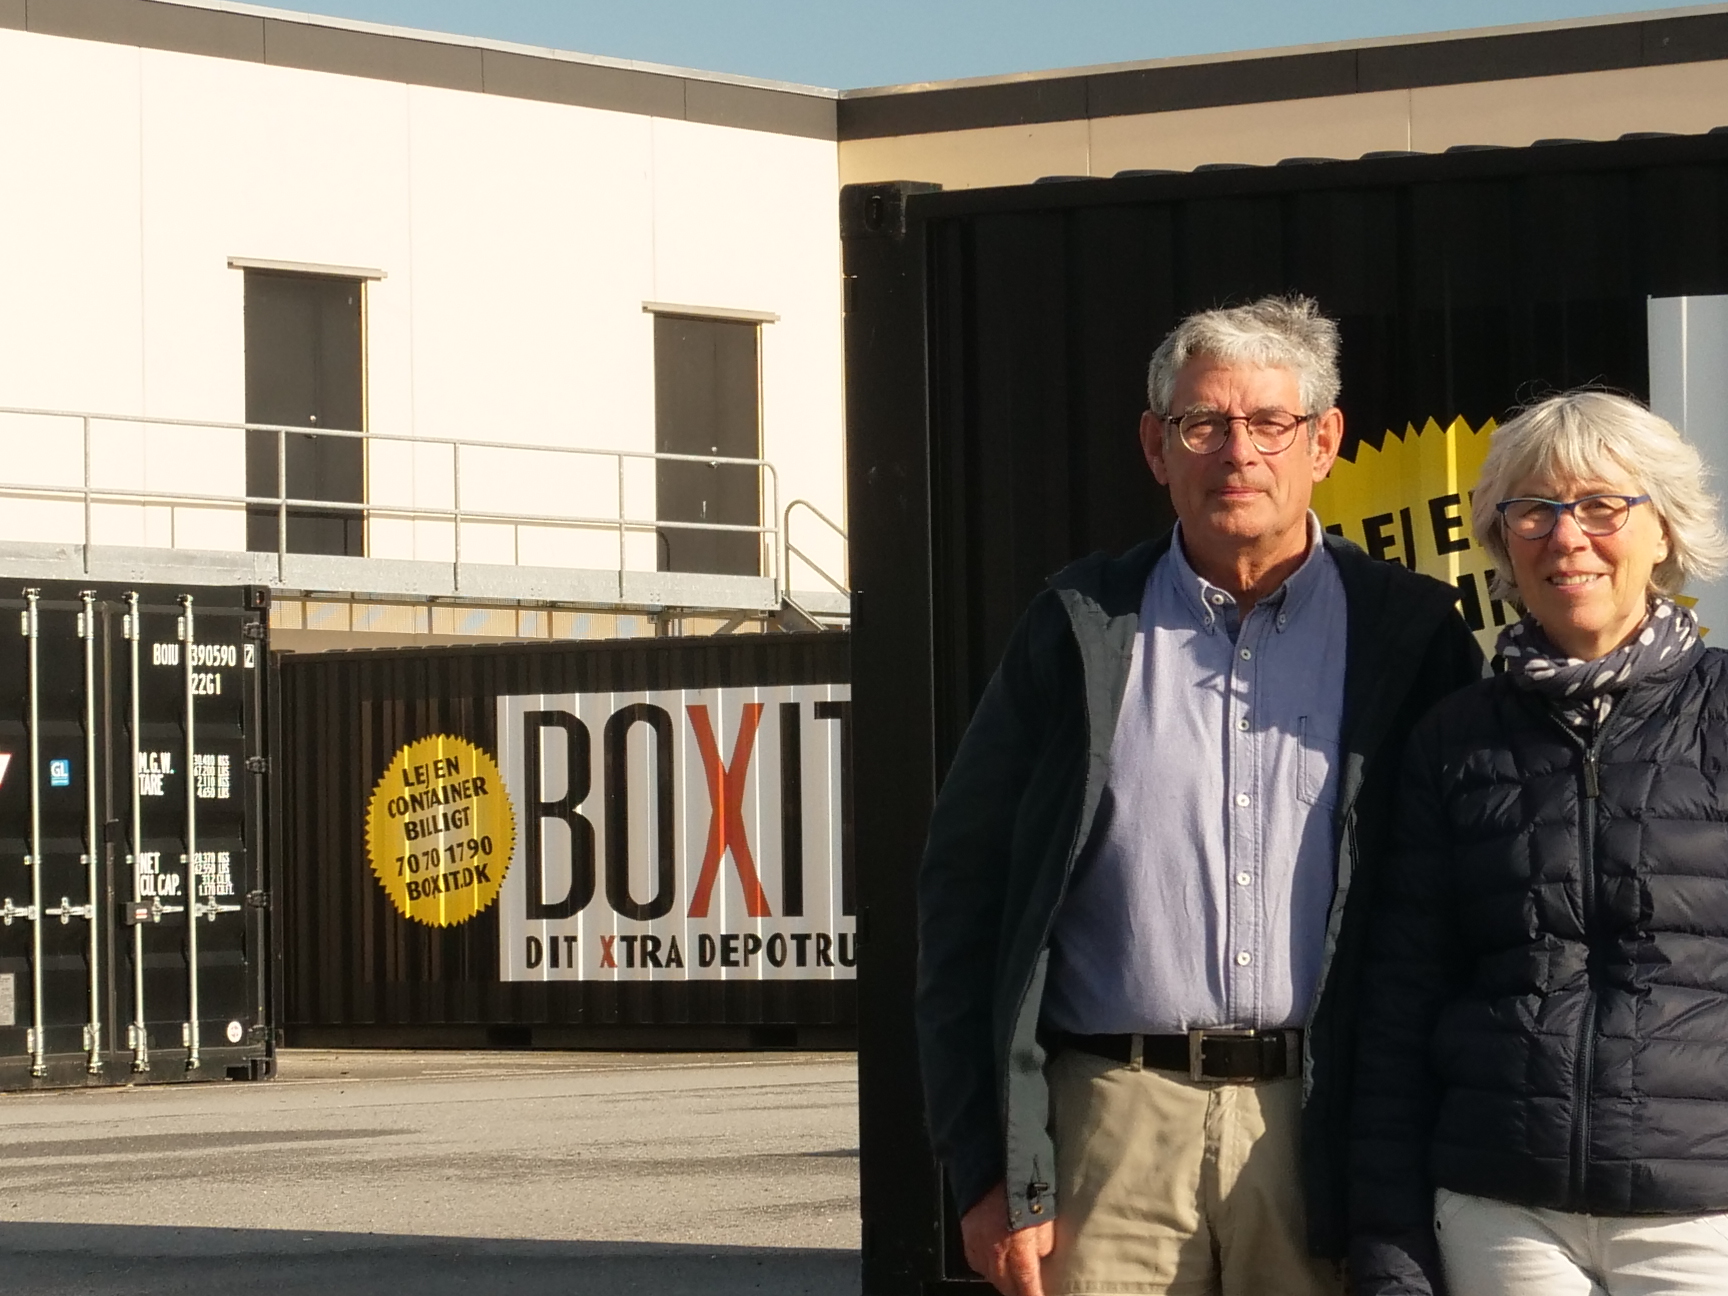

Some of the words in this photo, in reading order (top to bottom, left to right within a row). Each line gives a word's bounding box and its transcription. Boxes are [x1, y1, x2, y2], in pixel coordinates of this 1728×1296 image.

[1325, 507, 1416, 571] EJ
[153, 643, 179, 665] BOIU
[191, 644, 236, 666] 390590
[191, 673, 221, 695] 22G1
[51, 761, 68, 777] GL
[139, 774, 164, 795] TARE
[402, 763, 430, 788] LEJ
[433, 756, 460, 780] EN
[388, 776, 488, 818] CONTAINER
[404, 807, 470, 841] BILLIGT
[140, 852, 160, 874] NET
[396, 854, 420, 876] 70
[423, 848, 440, 871] 70
[444, 835, 493, 864] 1790
[406, 863, 491, 901] BOXIT.DK
[526, 935, 578, 969] DIT
[600, 935, 684, 969] XTRA
[699, 933, 857, 968] DEPOTRU
